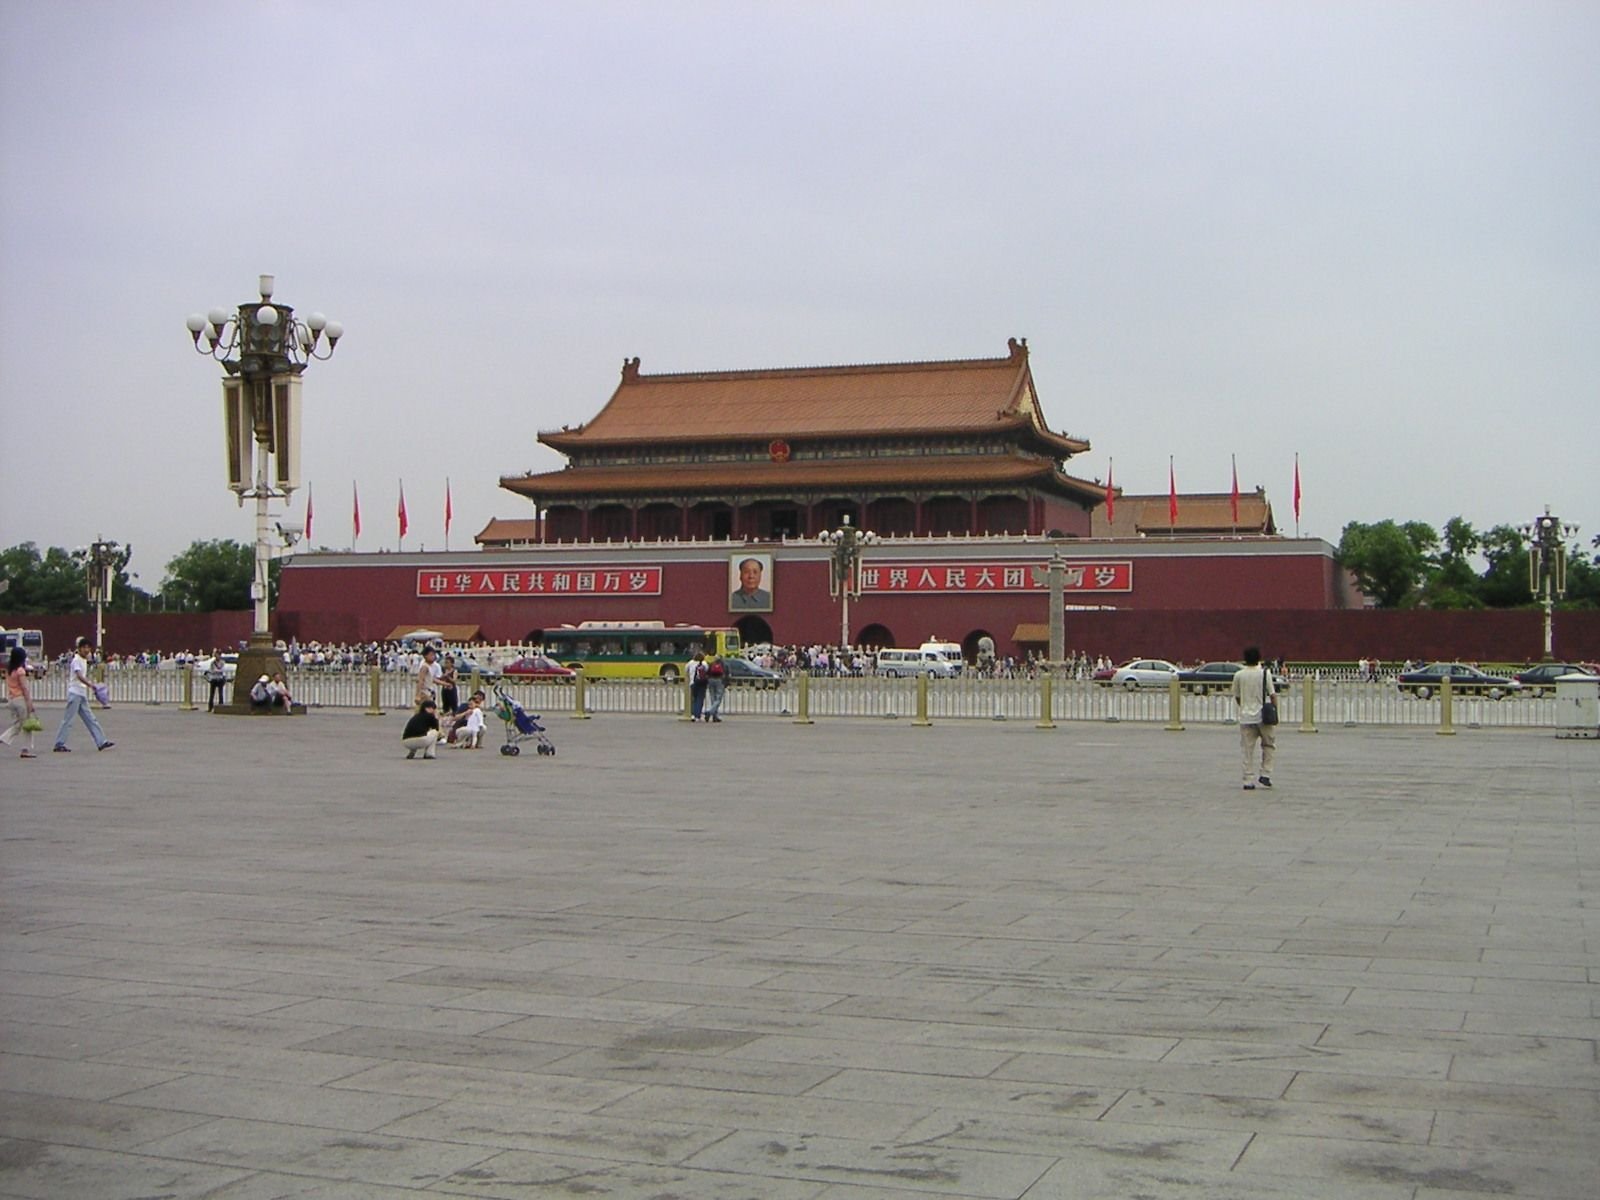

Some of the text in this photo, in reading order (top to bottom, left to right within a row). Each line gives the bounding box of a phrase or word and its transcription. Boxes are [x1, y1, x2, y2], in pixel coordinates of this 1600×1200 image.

[429, 572, 648, 593] 中华人民共和国万岁
[861, 567, 1115, 589] 世界人民大团万岁
